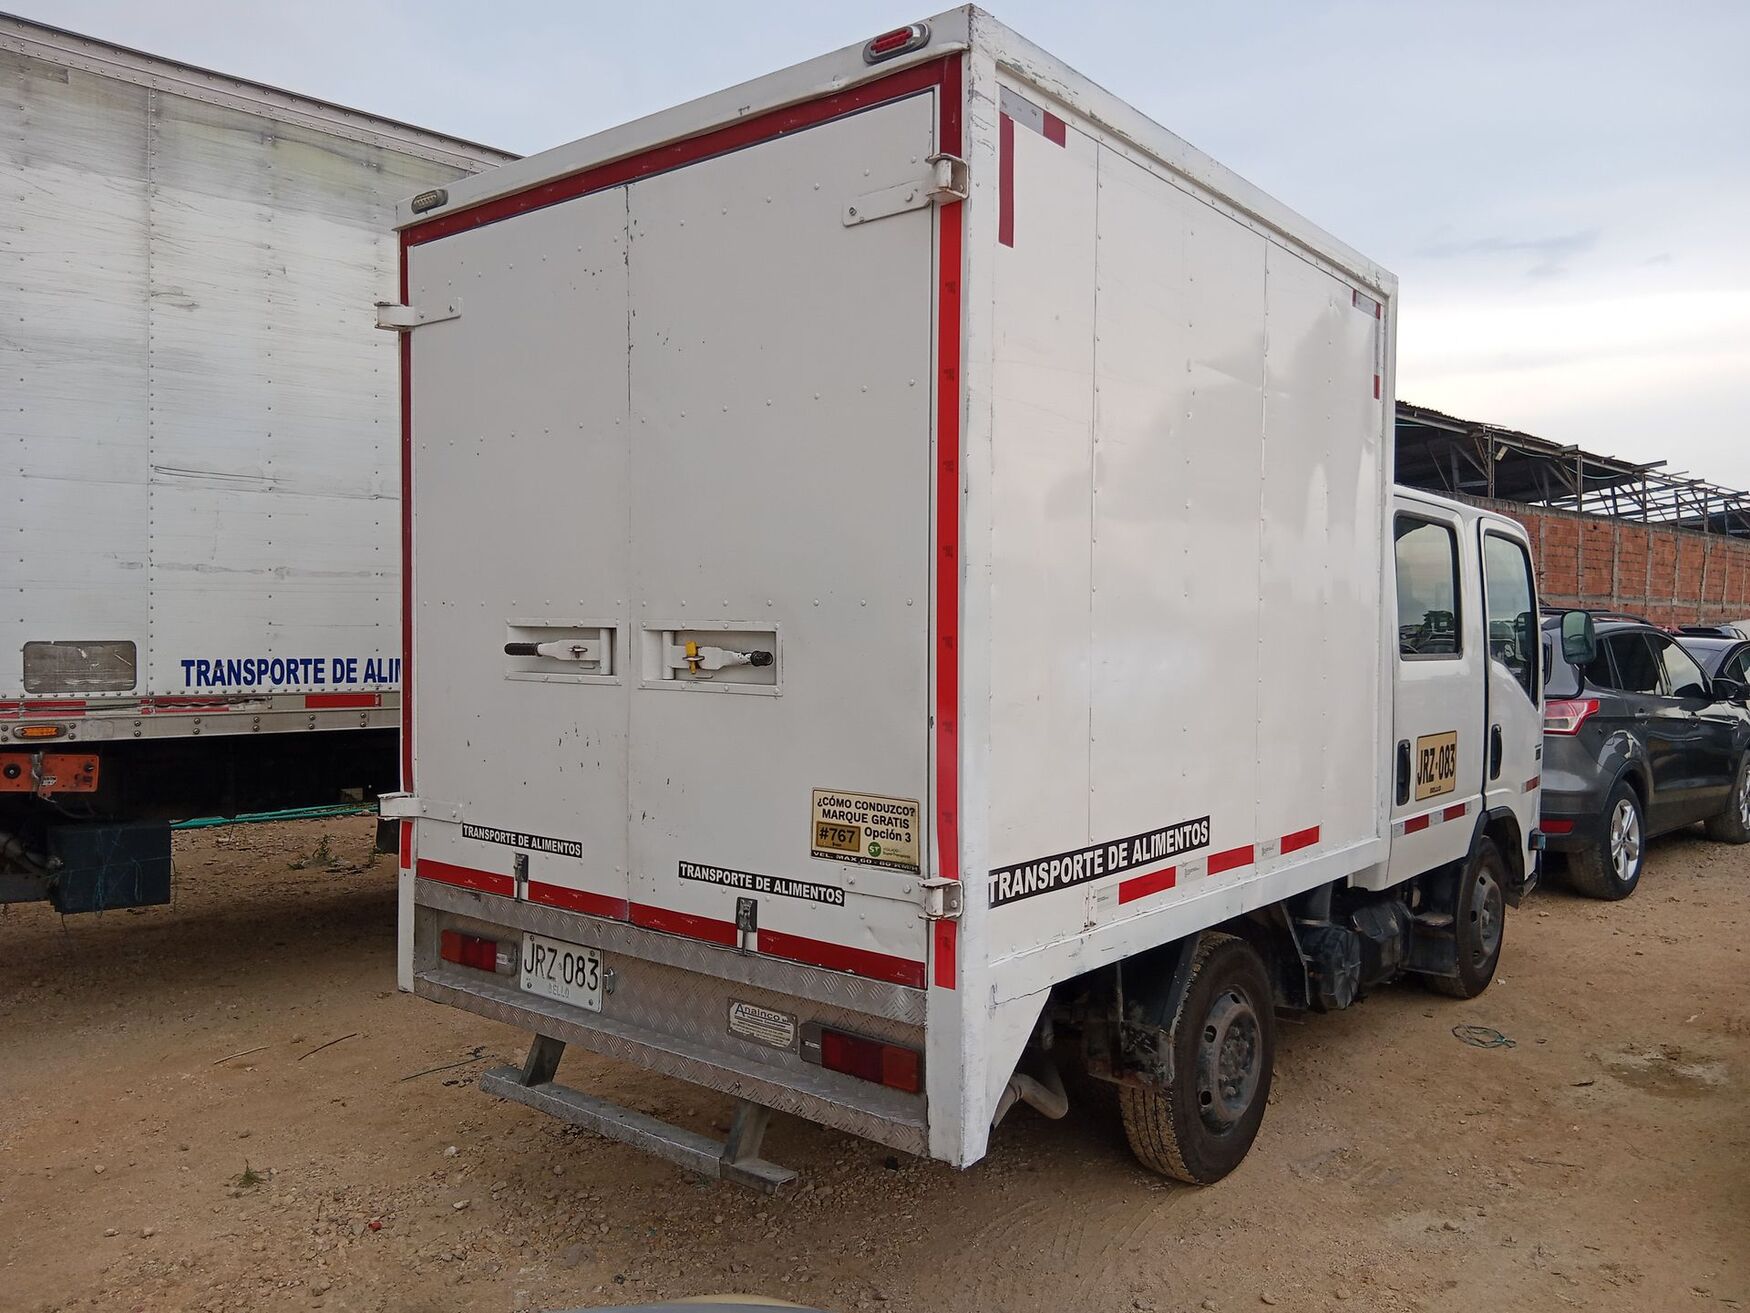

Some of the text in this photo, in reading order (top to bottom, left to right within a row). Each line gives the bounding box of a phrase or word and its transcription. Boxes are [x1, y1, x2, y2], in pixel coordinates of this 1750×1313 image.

[181, 658, 326, 687] TRANSPORTE
[332, 658, 358, 684] DE
[817, 795, 915, 816] ¿CÓMO CONDUZCO?
[822, 808, 909, 829] MARQUE GRATIS
[463, 825, 581, 856] TRANSPORTE DE ALIMENTOS
[819, 827, 855, 843] #767
[864, 827, 911, 843] Opción 3
[988, 820, 1209, 903] TRANSPORTE DE ALIMENTOS
[680, 863, 843, 904] TRANSPORTE DE ALIMENTOS
[734, 1003, 780, 1021] Anainco
